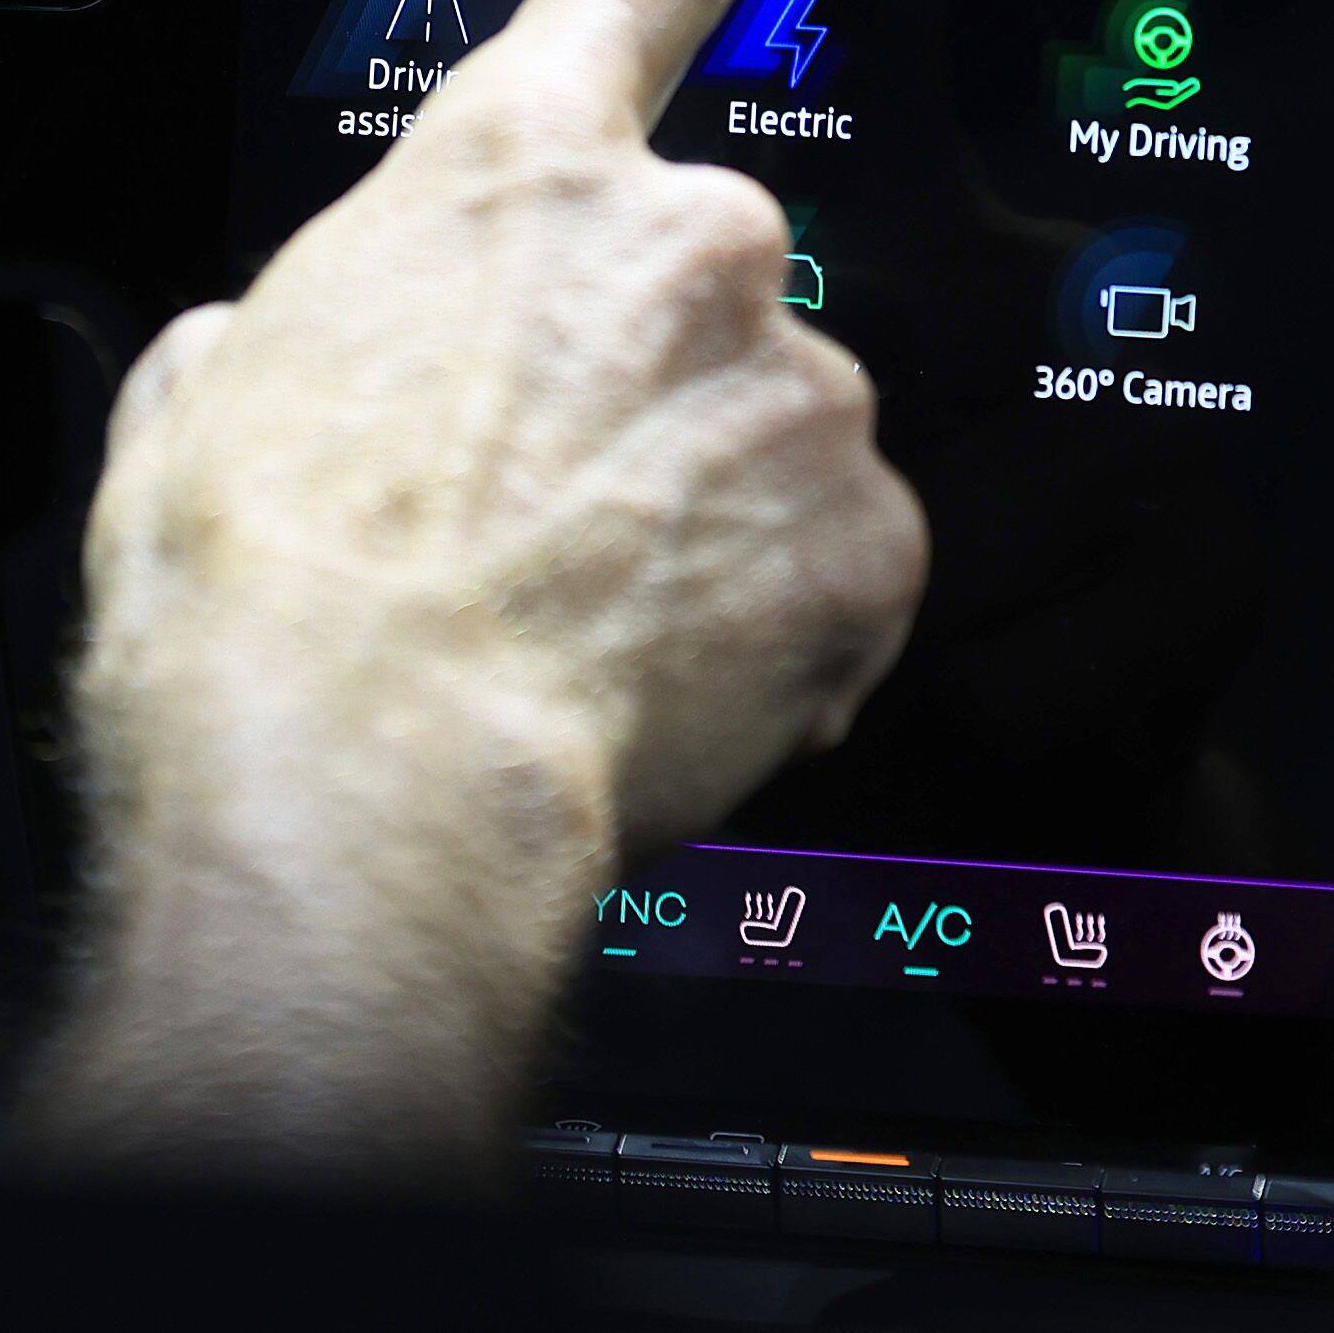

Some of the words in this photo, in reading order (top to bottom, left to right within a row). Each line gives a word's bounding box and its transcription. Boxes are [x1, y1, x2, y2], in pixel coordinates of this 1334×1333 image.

[368, 57, 461, 93] Drivi
[337, 106, 424, 139] assis
[728, 100, 854, 141] Electric
[1069, 119, 1120, 164] My
[1128, 122, 1252, 172] Driving
[1033, 364, 1116, 403] 360°
[1122, 370, 1253, 412] Camera
[591, 886, 689, 928] YNC
[872, 900, 974, 952] A/C
